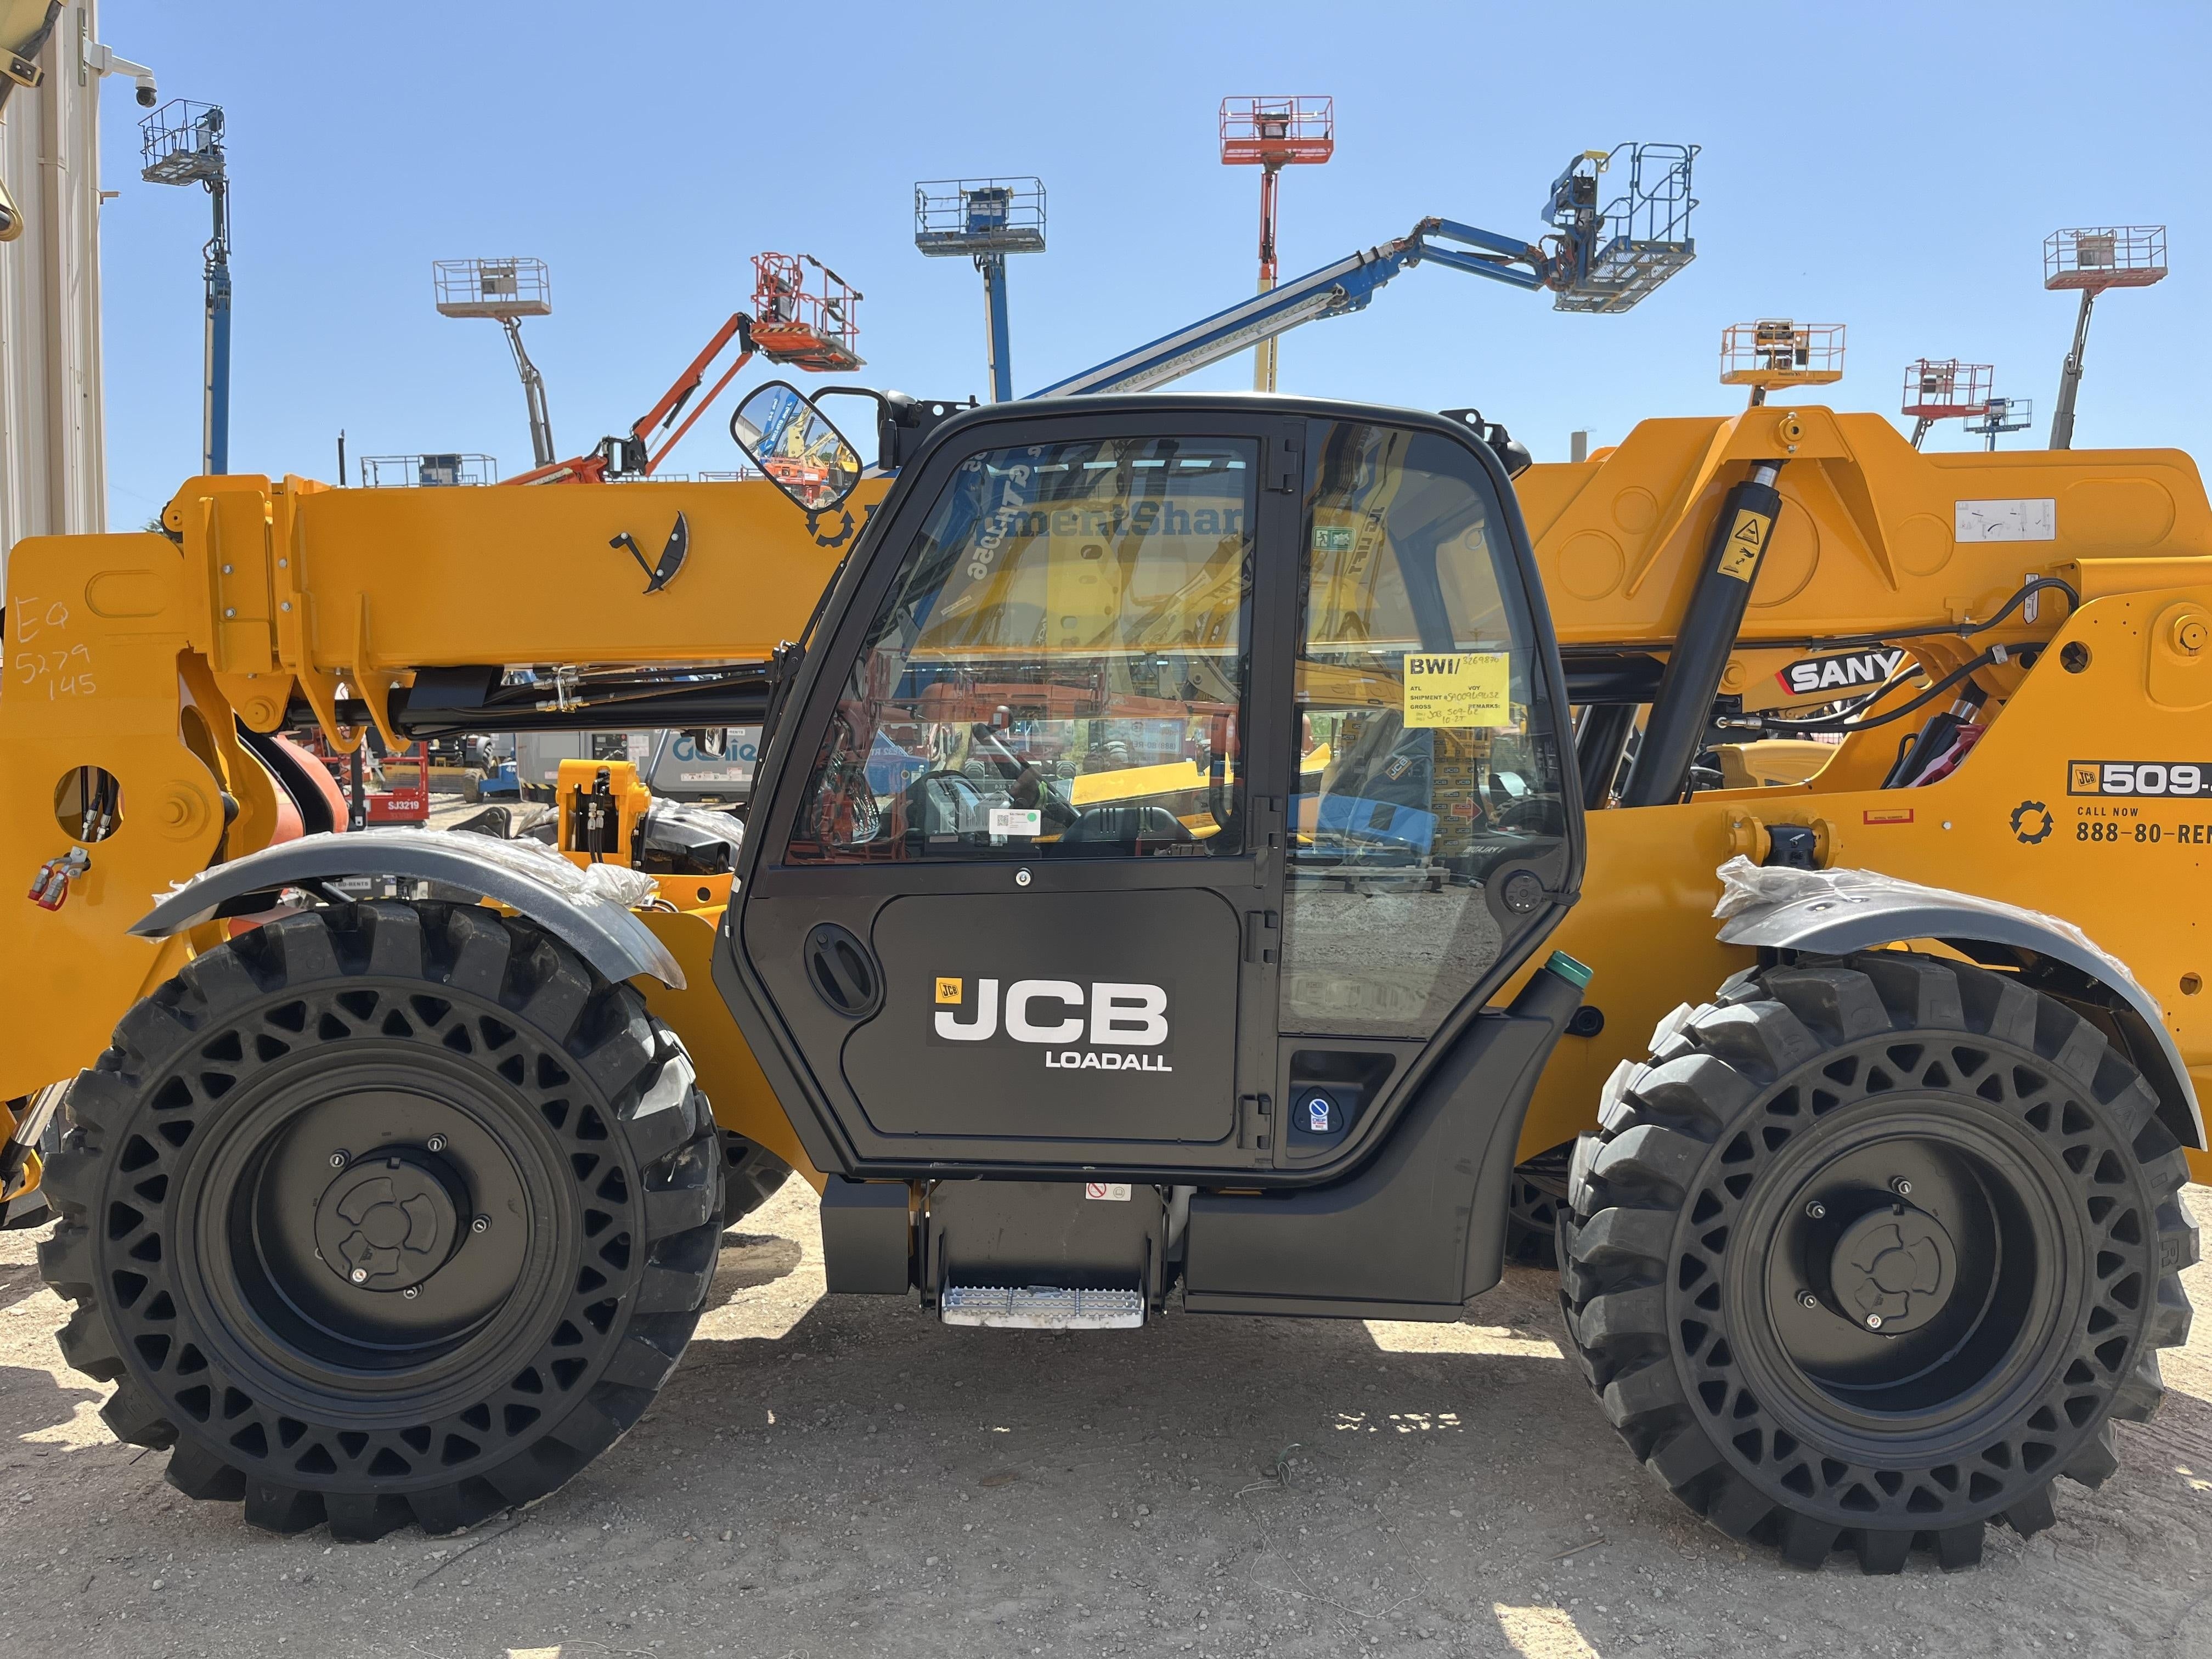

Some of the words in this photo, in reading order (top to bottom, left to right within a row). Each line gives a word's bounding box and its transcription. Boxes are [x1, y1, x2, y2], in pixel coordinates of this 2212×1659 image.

[16, 644, 91, 684] 5279
[1791, 650, 1903, 692] SANY
[50, 673, 97, 701] 145
[1391, 758, 1409, 776] JCB
[2079, 771, 2096, 786] JCB
[2102, 764, 2212, 795] 509-
[388, 800, 419, 810] SJ3219
[2077, 806, 2107, 816] CALL
[2113, 808, 2138, 816] NOW
[943, 984, 958, 996] JCB
[935, 978, 1169, 1046] JCB
[1046, 1051, 1172, 1072] LOADALL
